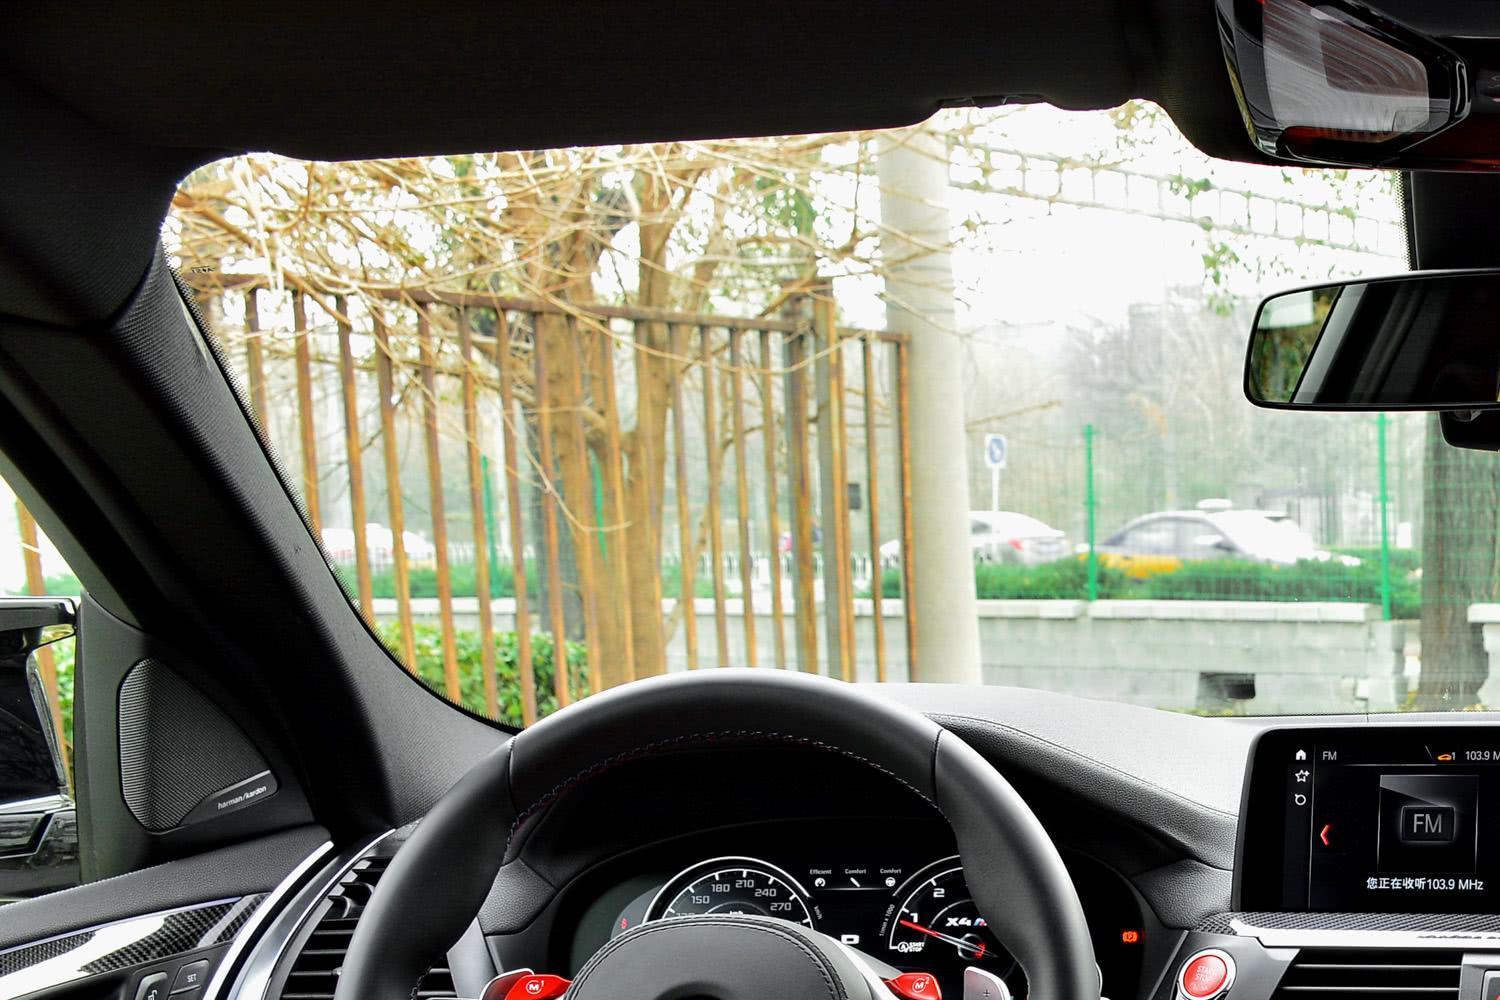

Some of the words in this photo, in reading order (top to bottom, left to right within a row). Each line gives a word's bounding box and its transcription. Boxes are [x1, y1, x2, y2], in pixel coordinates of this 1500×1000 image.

[1322, 752, 1337, 760] FM
[1465, 751, 1490, 760] 103.9
[217, 786, 267, 810] harman/kardon
[1413, 814, 1442, 833] FM
[711, 884, 731, 892] 180
[735, 879, 755, 888] 210
[1366, 877, 1455, 890] 您正在收听103.9
[1458, 879, 1484, 890] MHz
[754, 888, 777, 897] 240
[933, 888, 945, 898] 2
[691, 895, 710, 904] 150
[770, 903, 792, 911] 270
[910, 912, 918, 923] 1
[945, 917, 972, 927] X4
[187, 973, 197, 983] SET
